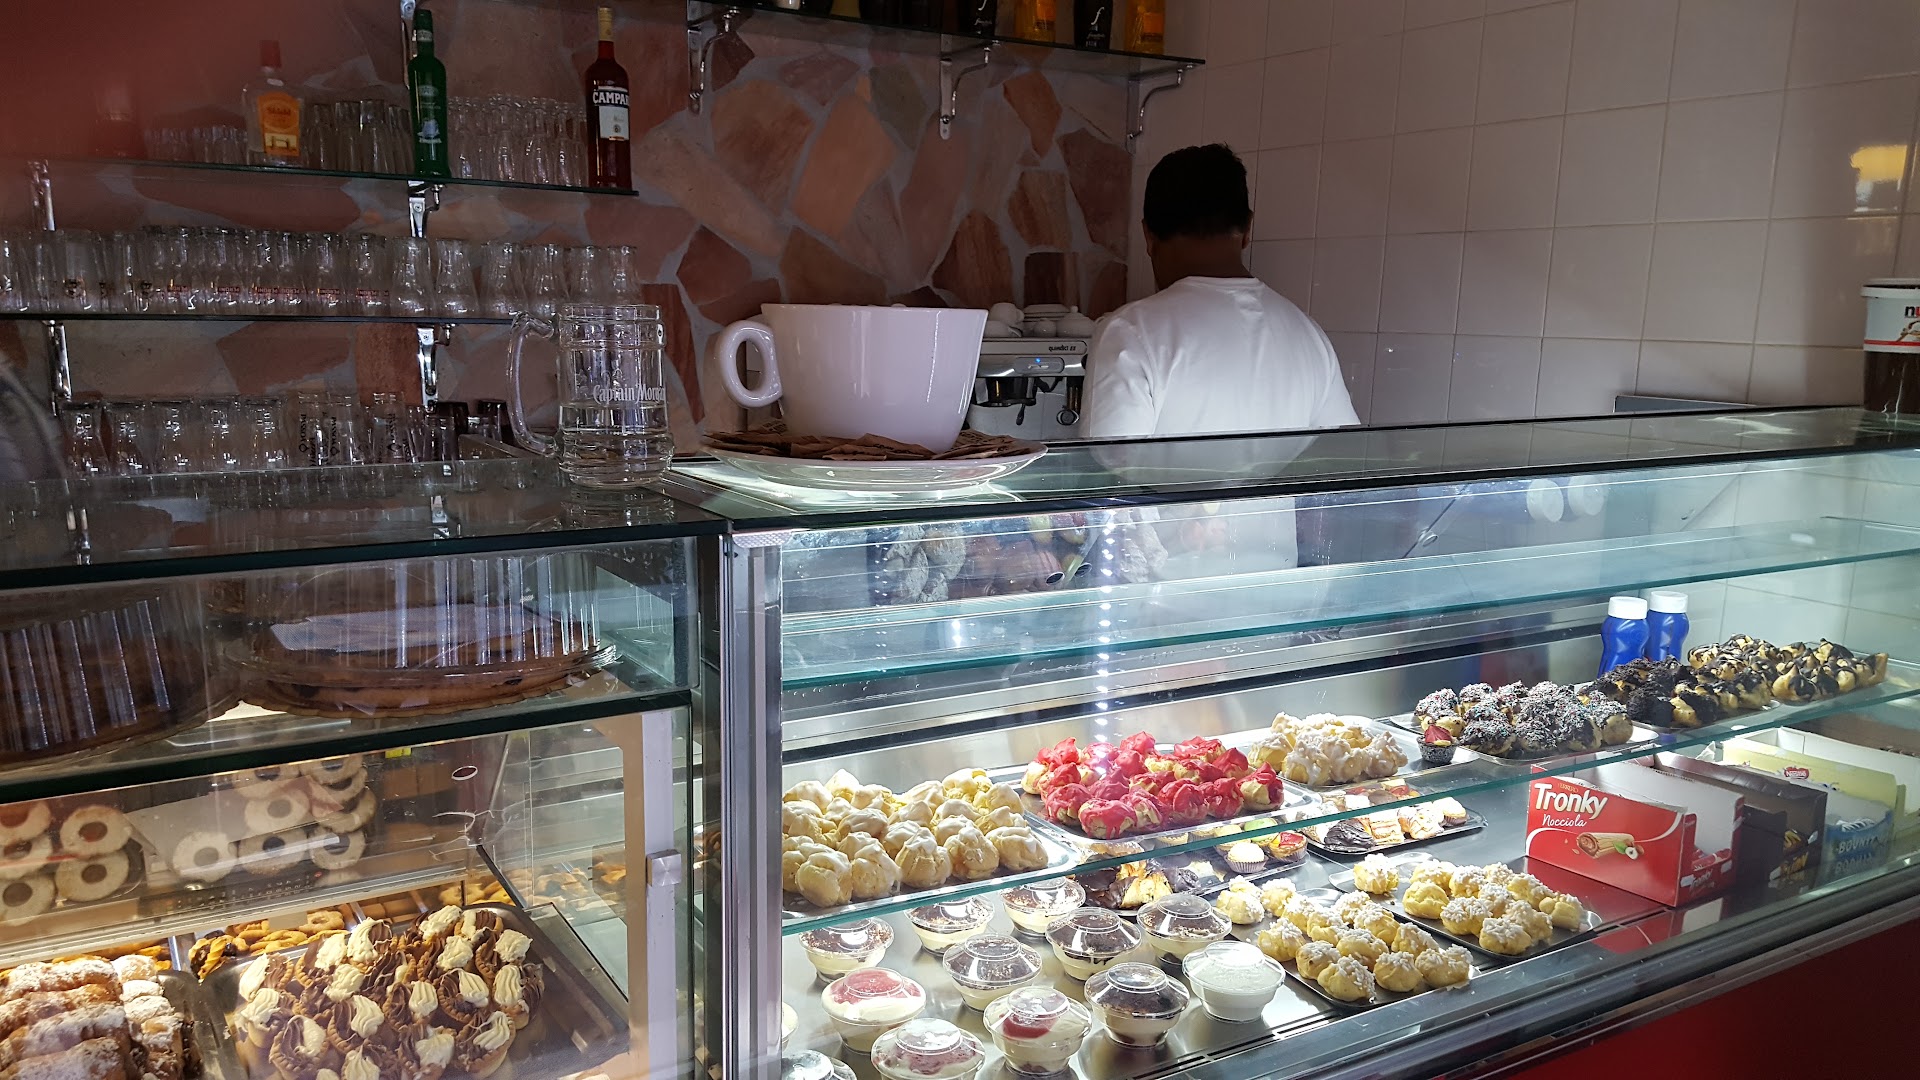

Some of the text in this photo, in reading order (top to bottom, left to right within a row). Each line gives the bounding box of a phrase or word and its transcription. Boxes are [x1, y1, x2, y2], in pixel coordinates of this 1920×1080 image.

[592, 91, 630, 106] CAMPAR
[593, 383, 665, 405] Captain Morga
[1534, 783, 1608, 820] Tronky
[1542, 814, 1588, 827] Nocciola
